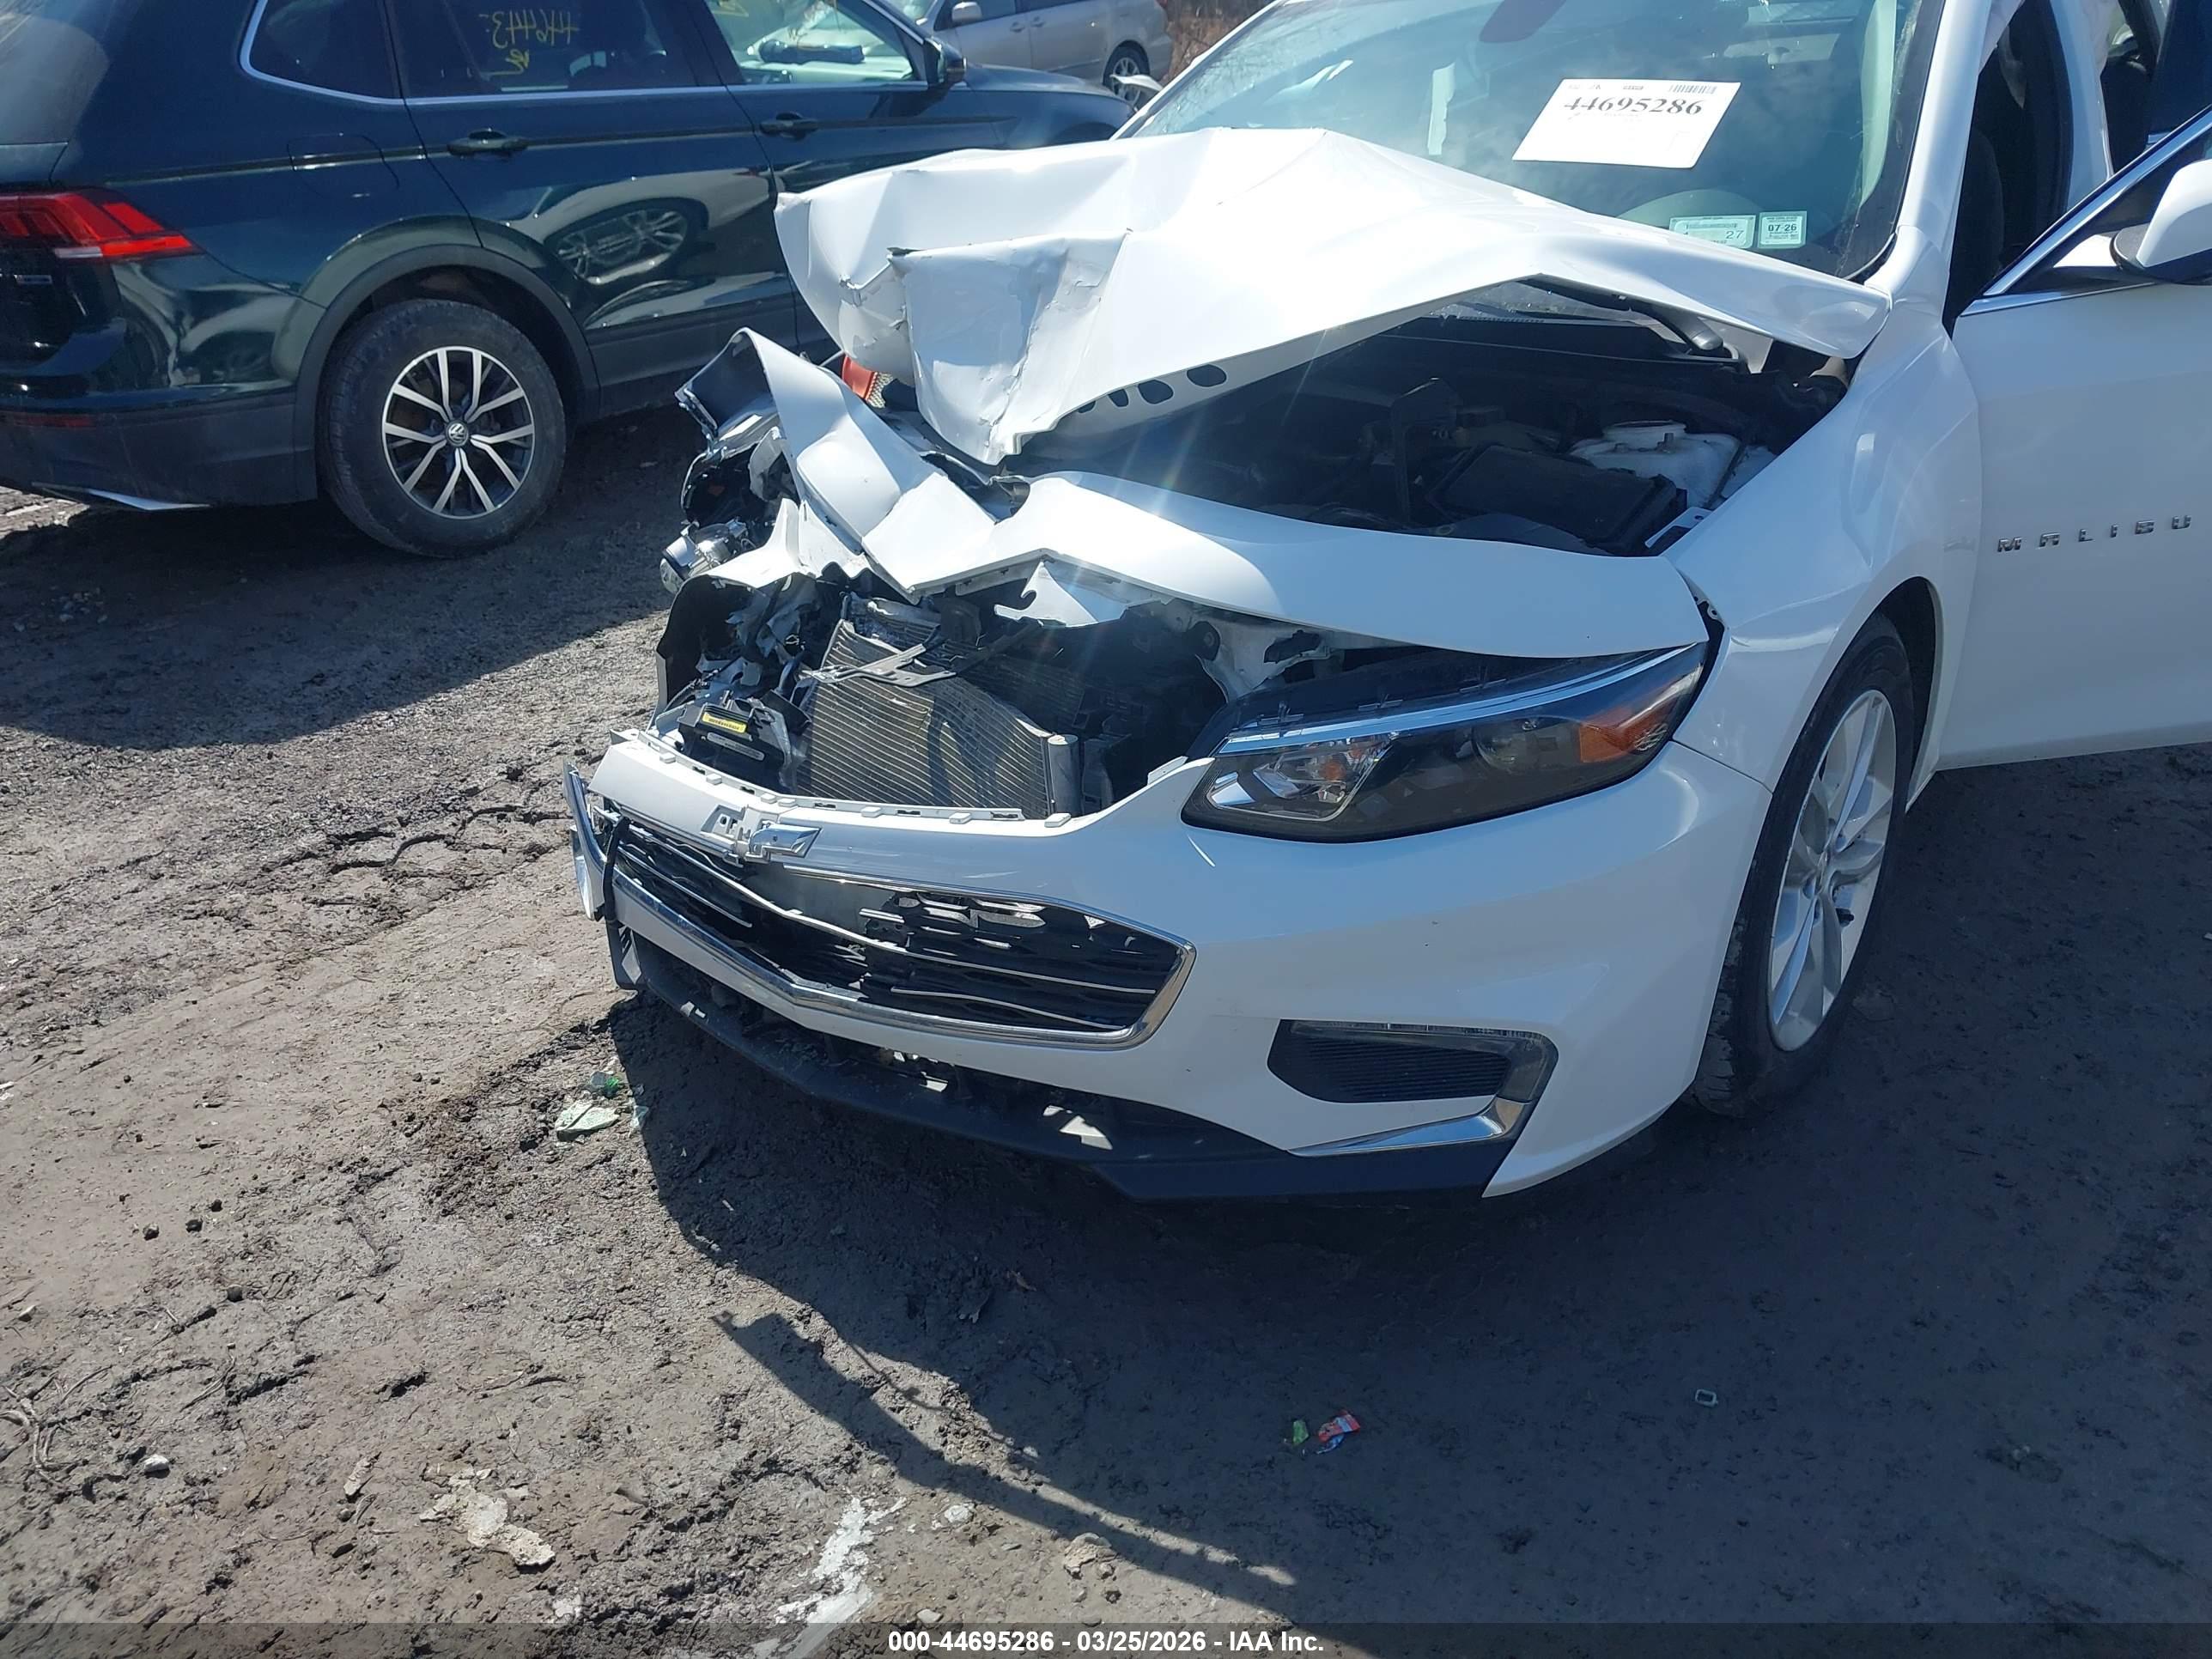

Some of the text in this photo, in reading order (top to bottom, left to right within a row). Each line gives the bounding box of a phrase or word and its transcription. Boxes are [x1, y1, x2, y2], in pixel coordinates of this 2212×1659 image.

[1564, 96, 1705, 115] 44695286
[1725, 229, 1745, 240] 27
[1784, 223, 1797, 232] 26
[1997, 515, 2191, 552] MALIBU
